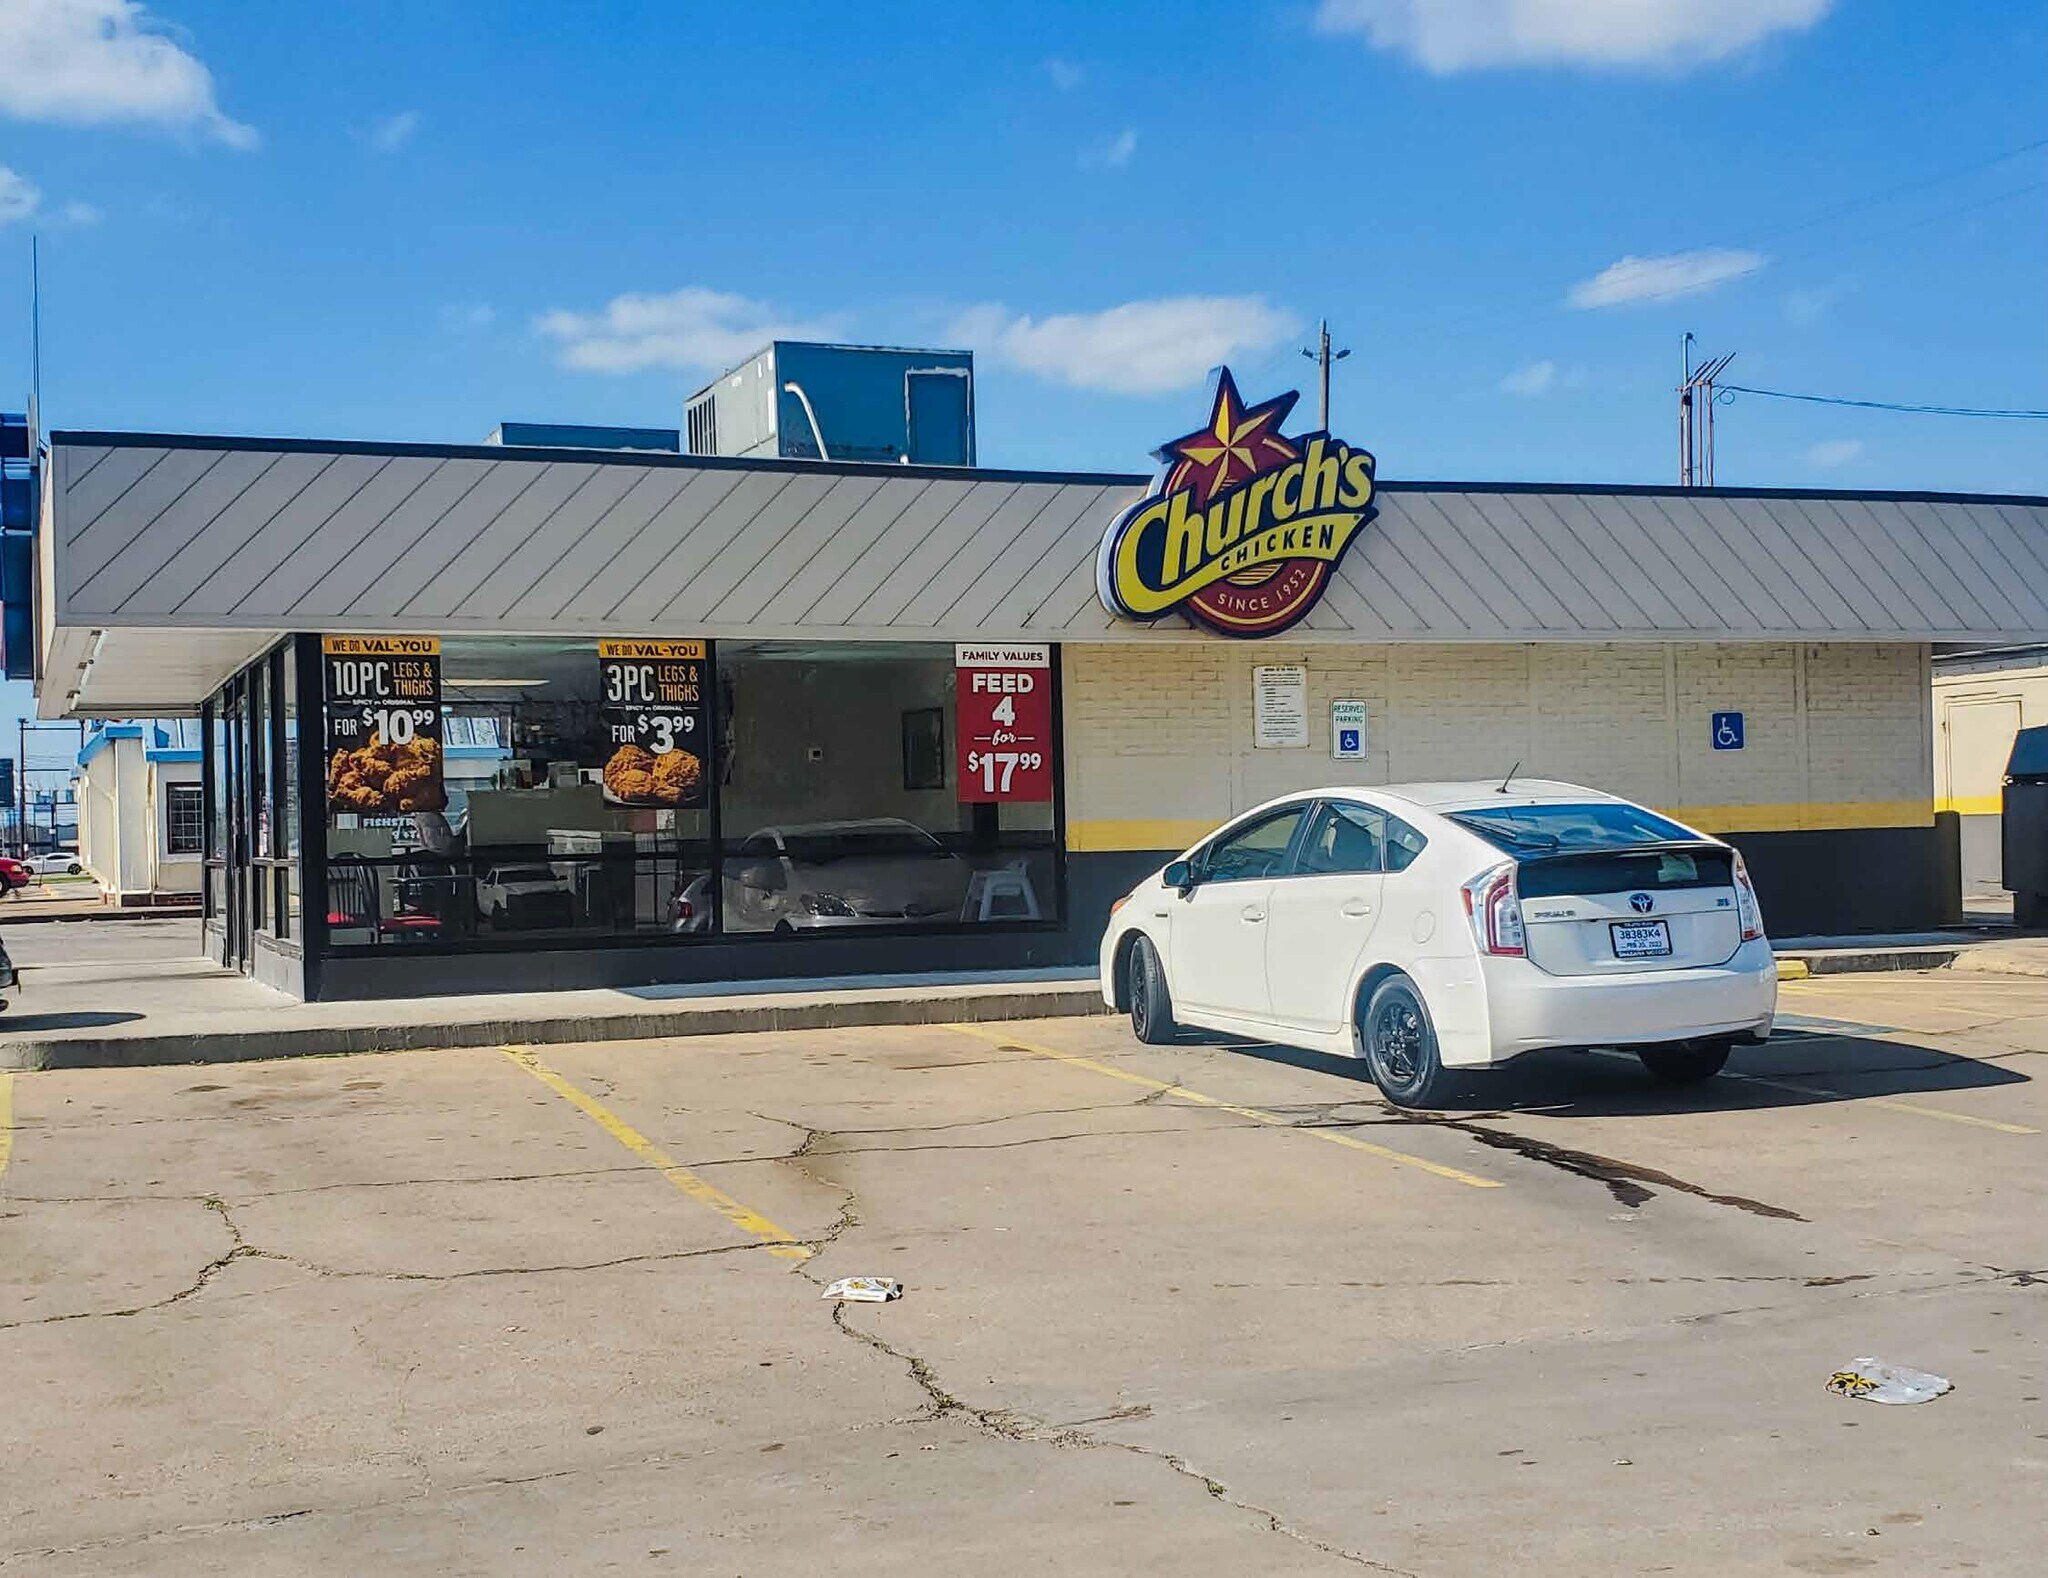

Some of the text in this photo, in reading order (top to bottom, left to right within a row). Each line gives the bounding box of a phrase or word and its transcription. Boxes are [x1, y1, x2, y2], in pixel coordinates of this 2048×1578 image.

[1116, 438, 1373, 614] Church's
[1220, 523, 1335, 572] CHICKEN
[1217, 568, 1307, 611] SINCE 1952
[332, 640, 432, 652] WE DO VAL-YOU
[606, 644, 698, 657] WE DO VAL-YOU
[962, 651, 1043, 661] FAMILY VALUES
[393, 661, 433, 678] LEGS &
[658, 665, 698, 682] LEGS &
[333, 661, 390, 696] 10PC
[607, 664, 655, 702] 3PC
[972, 673, 1034, 693] FEED
[393, 679, 434, 696] THIGHS
[658, 684, 699, 702] THIGHS
[992, 695, 1016, 727] 4
[1333, 704, 1364, 713] RESERVED
[334, 718, 358, 736] FOR
[1335, 715, 1363, 723] PARKING
[612, 724, 636, 743] FOR
[991, 729, 1017, 746] for
[1619, 929, 1661, 939] 38383K4
